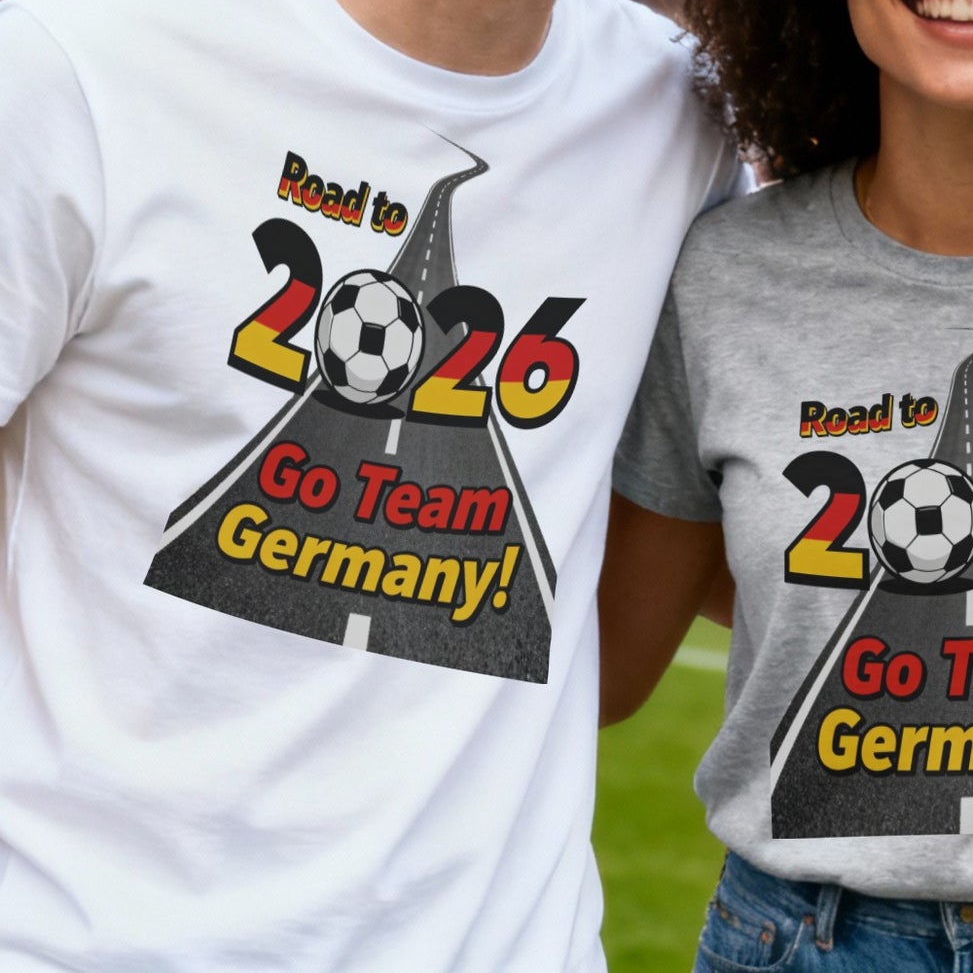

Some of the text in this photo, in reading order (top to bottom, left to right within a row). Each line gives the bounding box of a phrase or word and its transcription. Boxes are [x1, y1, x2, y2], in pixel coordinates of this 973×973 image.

[278, 151, 408, 236] Road to
[800, 393, 939, 437] Road to
[258, 441, 513, 534] Go Team
[217, 502, 520, 625] Germany!
[841, 635, 926, 698] Go
